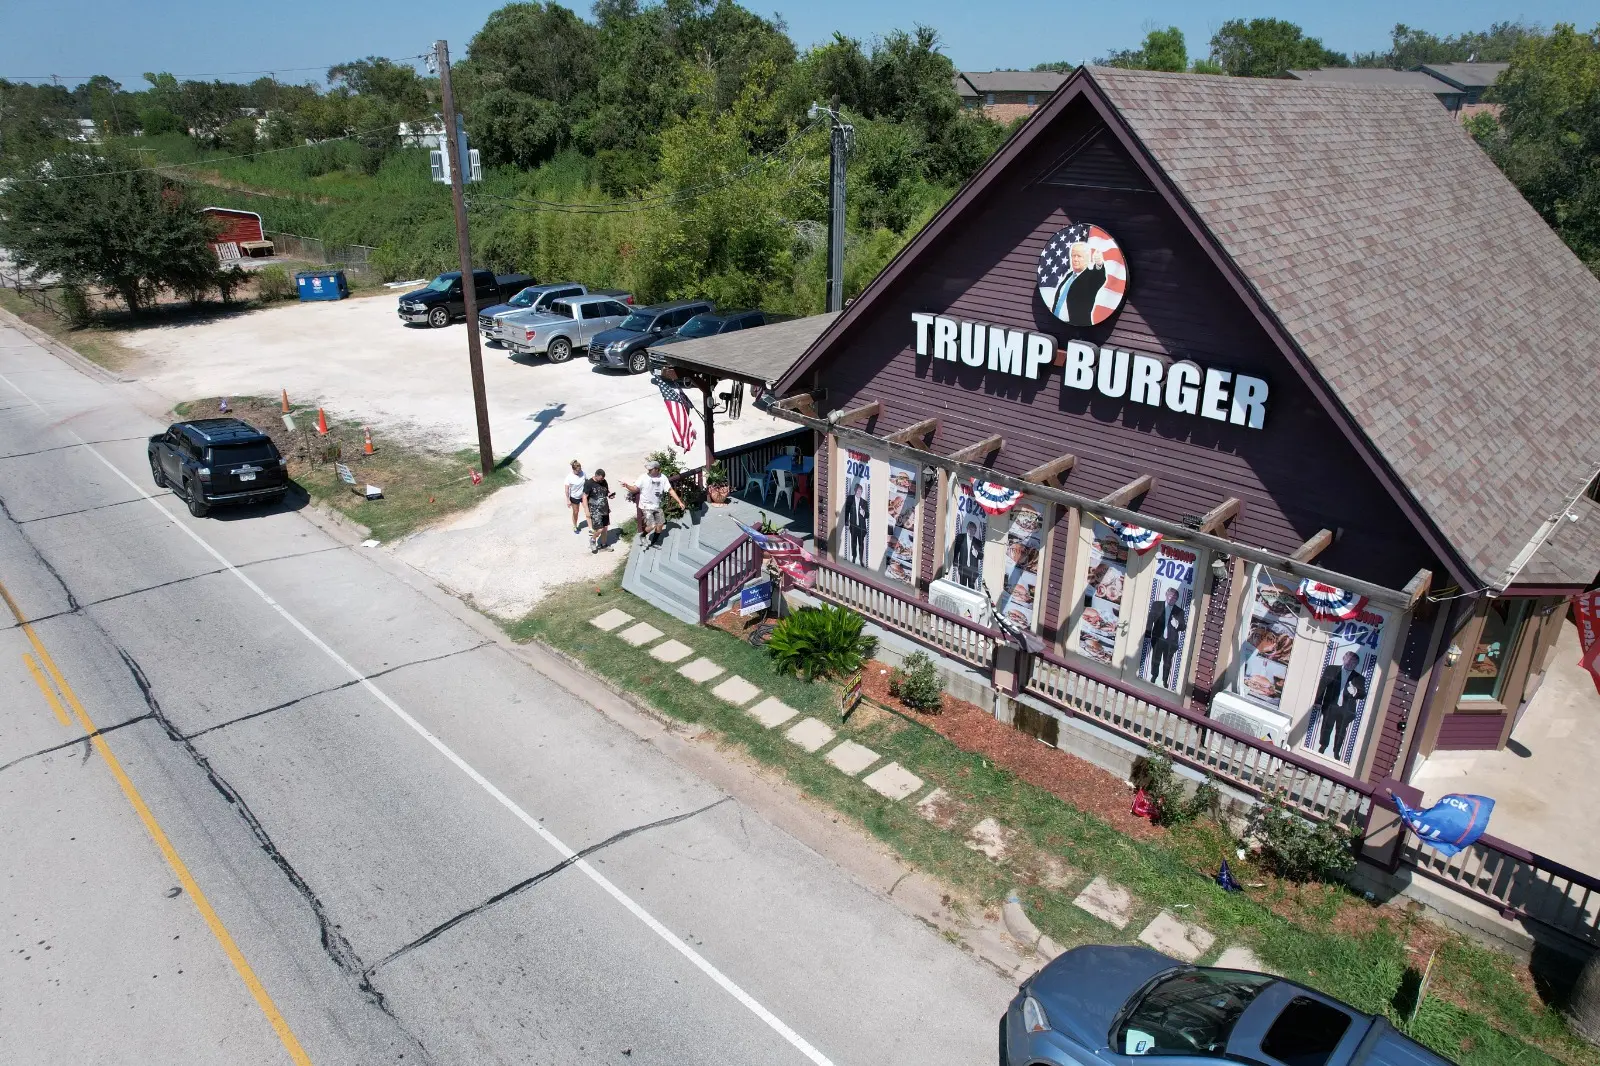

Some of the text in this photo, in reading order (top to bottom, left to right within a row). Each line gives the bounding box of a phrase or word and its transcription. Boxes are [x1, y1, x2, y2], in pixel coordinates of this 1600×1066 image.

[911, 312, 1269, 430] TRUMP BURGER
[846, 460, 870, 480] 2024
[1160, 543, 1197, 564] TRUMP
[1156, 558, 1194, 585] 2024
[1332, 620, 1381, 650] 2024
